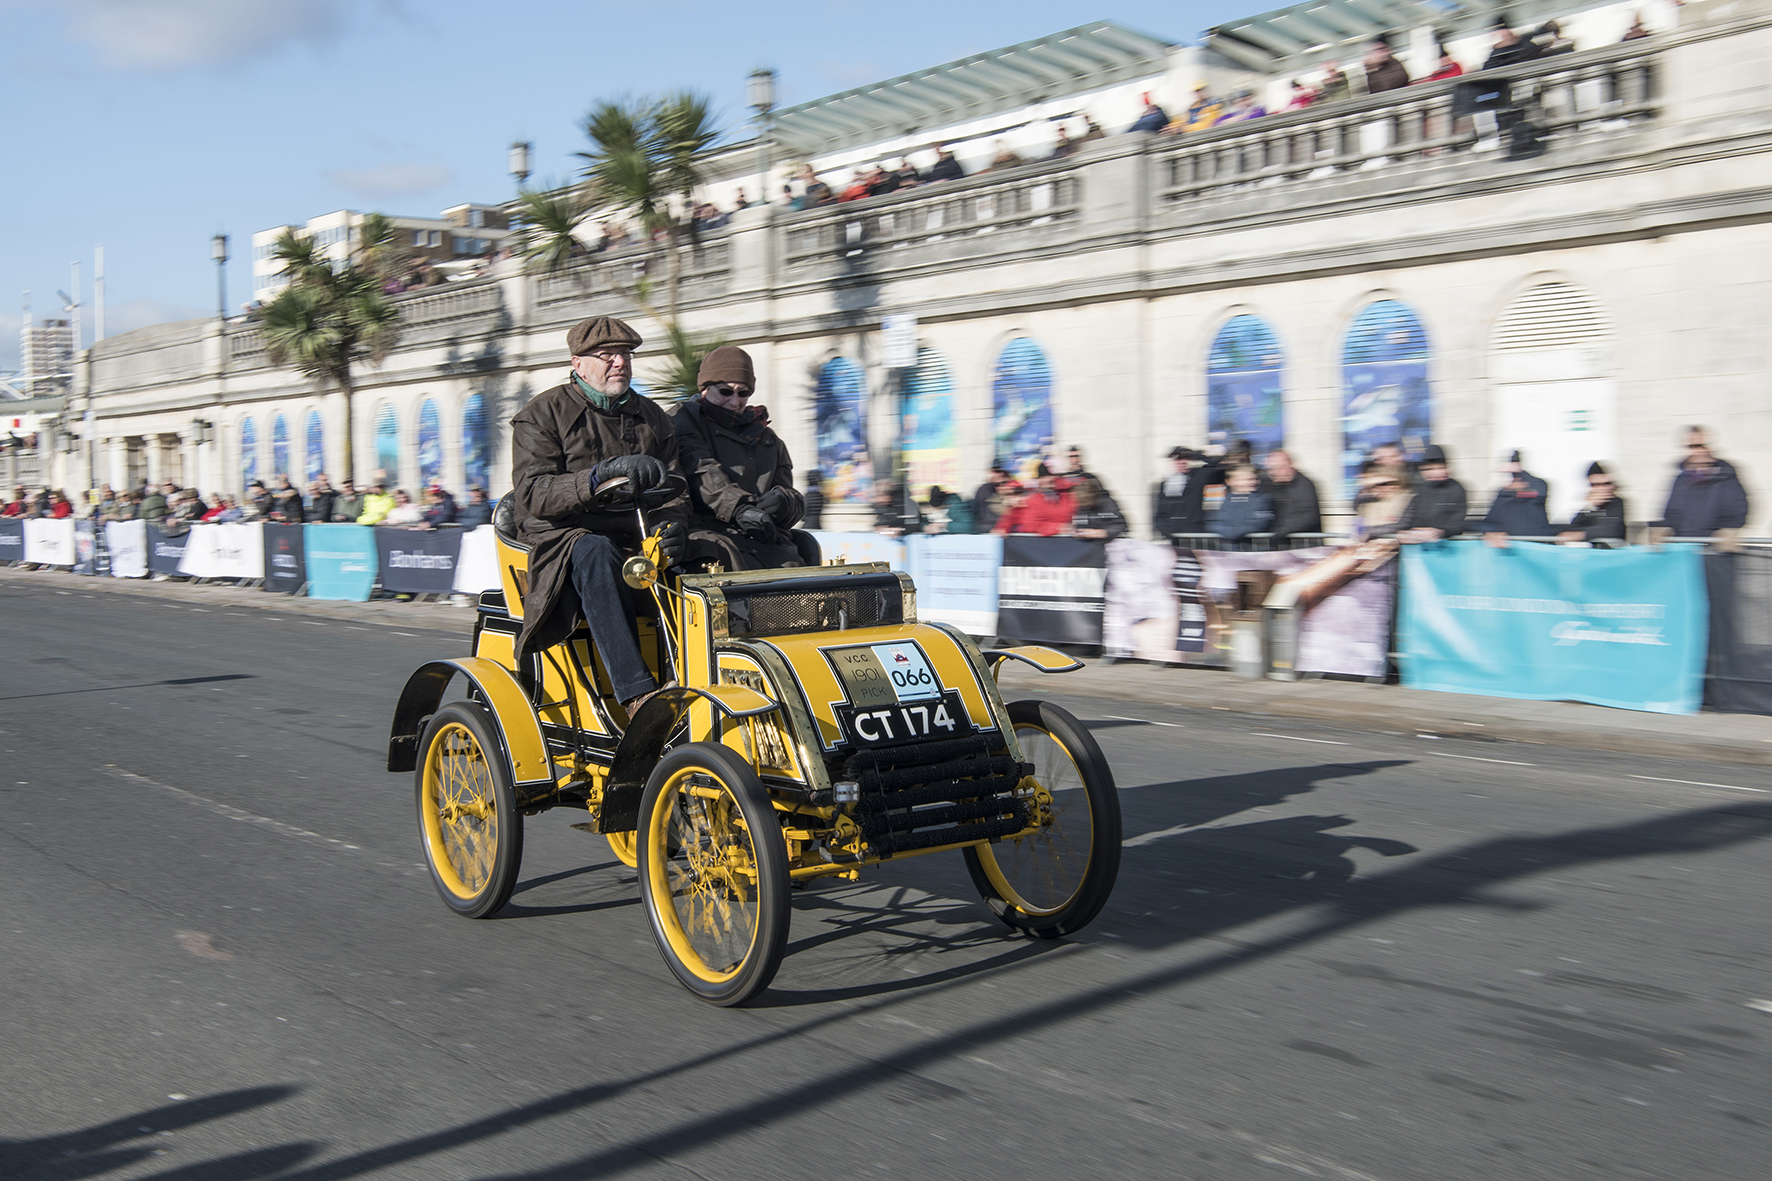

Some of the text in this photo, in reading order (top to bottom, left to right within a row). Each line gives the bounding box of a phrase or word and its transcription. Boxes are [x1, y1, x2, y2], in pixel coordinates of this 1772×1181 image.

[851, 667, 882, 683] 1901
[891, 667, 932, 688] 066
[861, 686, 888, 699] PICK
[854, 704, 956, 742] CT 174
